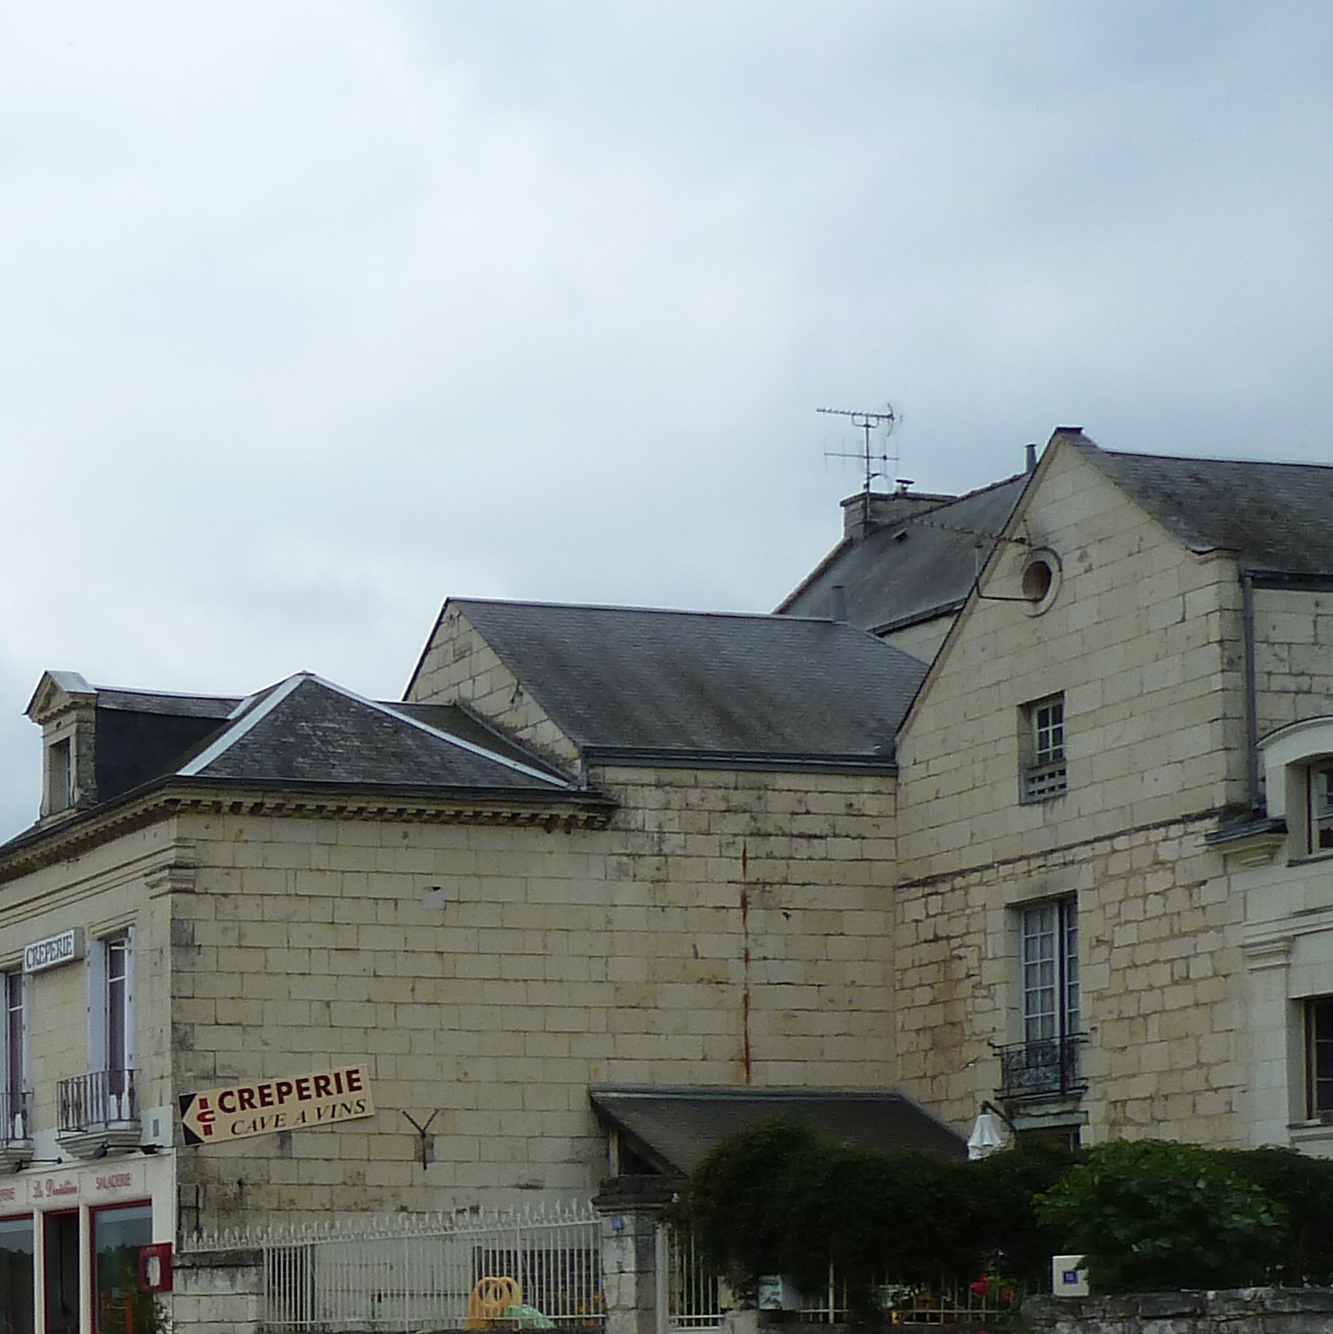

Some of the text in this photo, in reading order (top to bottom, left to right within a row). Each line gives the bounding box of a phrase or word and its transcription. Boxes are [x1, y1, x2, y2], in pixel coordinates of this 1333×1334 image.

[26, 934, 73, 970] CREPERIE
[218, 1069, 363, 1114] CREPERIE
[196, 1097, 216, 1136] ICI
[231, 1099, 366, 1136] CAVE A VINS
